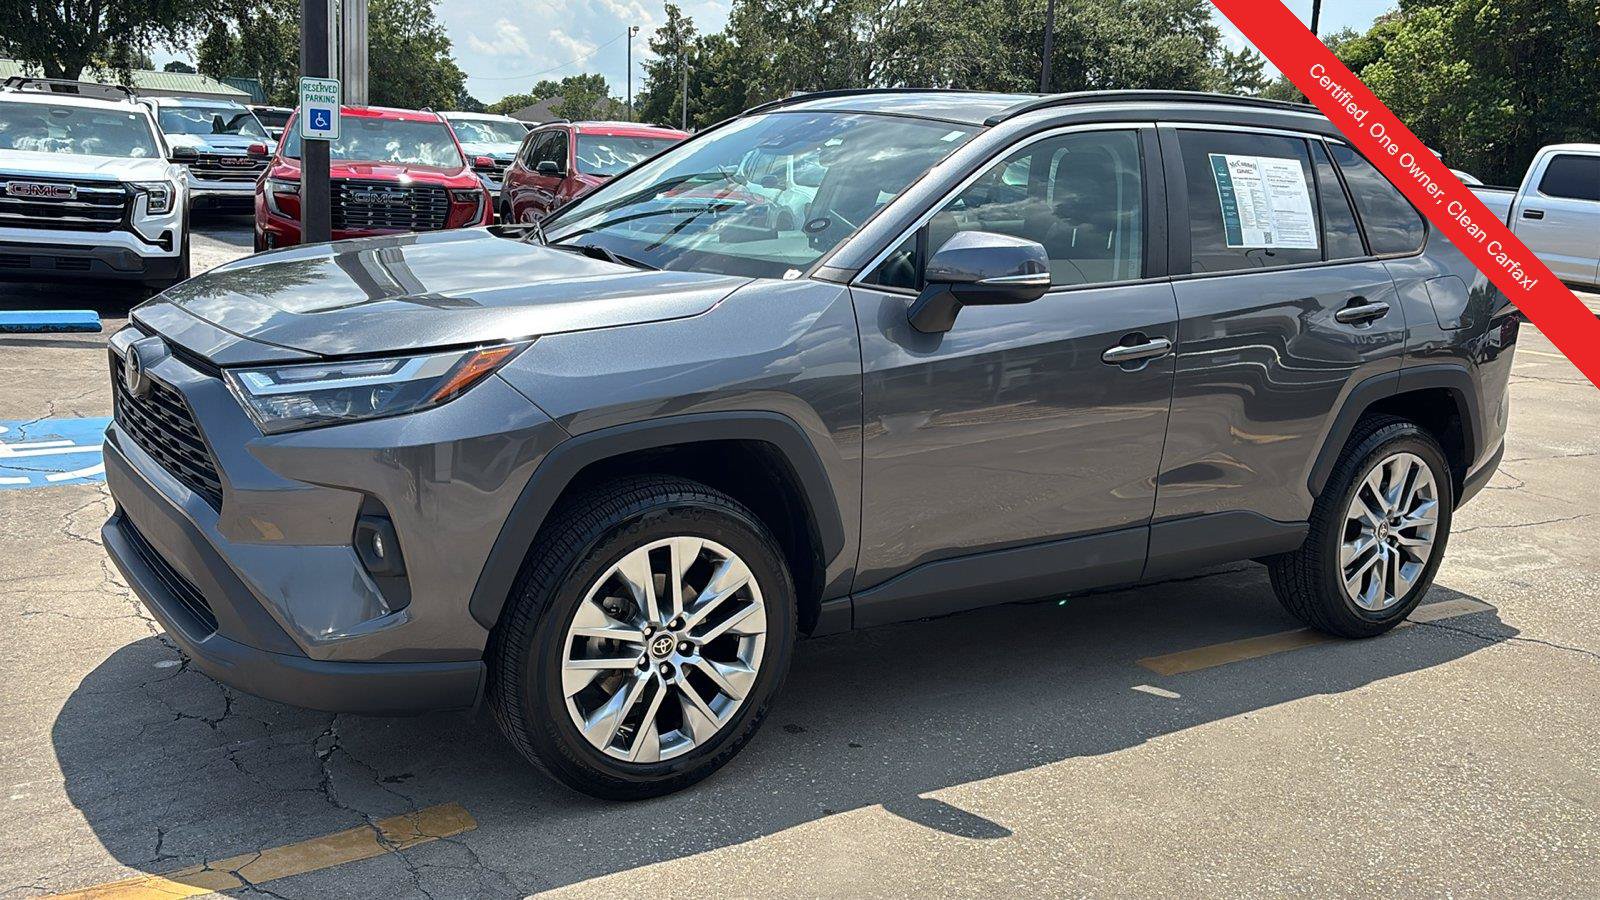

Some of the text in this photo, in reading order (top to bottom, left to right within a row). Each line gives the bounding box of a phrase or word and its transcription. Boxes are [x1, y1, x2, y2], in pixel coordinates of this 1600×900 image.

[303, 83, 338, 94] RESERVED
[305, 94, 336, 104] PARKING
[221, 157, 255, 166] GMC
[10, 183, 73, 198] GMC
[353, 192, 405, 205] GMC
